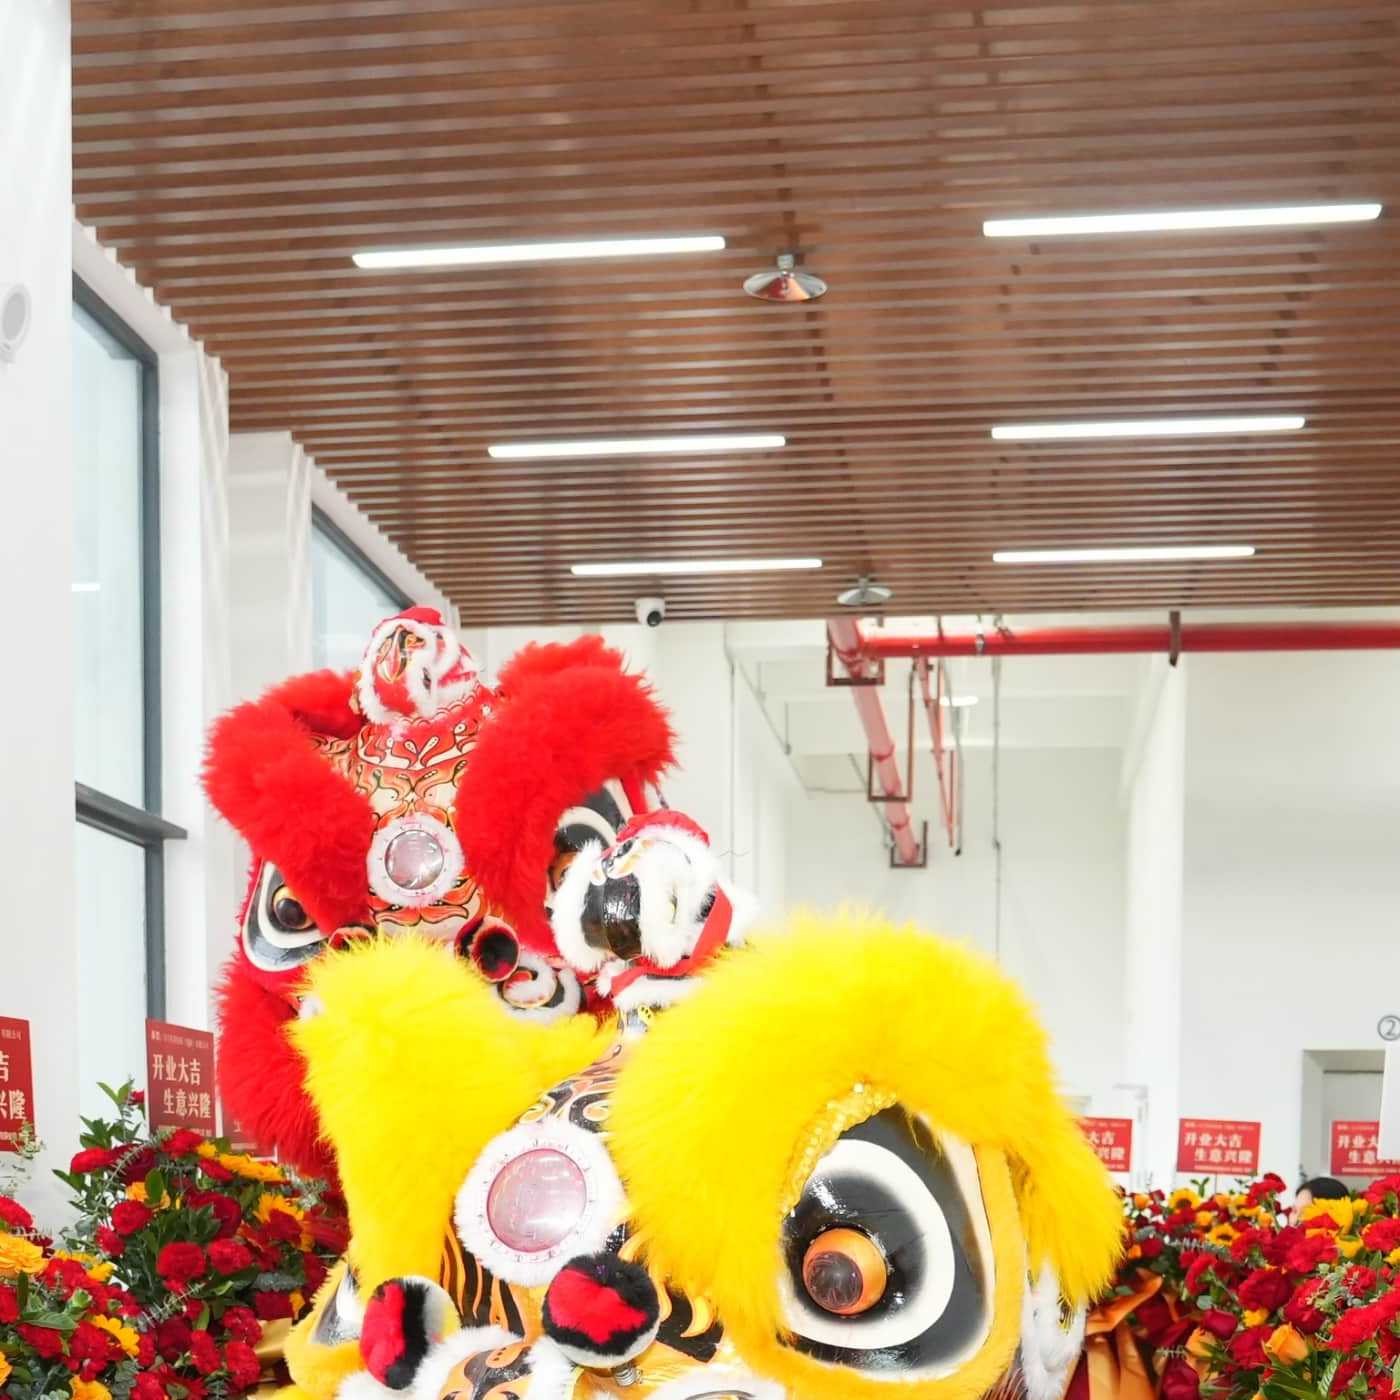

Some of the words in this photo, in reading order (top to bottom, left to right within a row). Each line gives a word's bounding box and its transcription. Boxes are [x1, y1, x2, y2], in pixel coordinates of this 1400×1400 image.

[152, 1054, 201, 1086] 开业大吉
[163, 1087, 212, 1119] 生意兴隆
